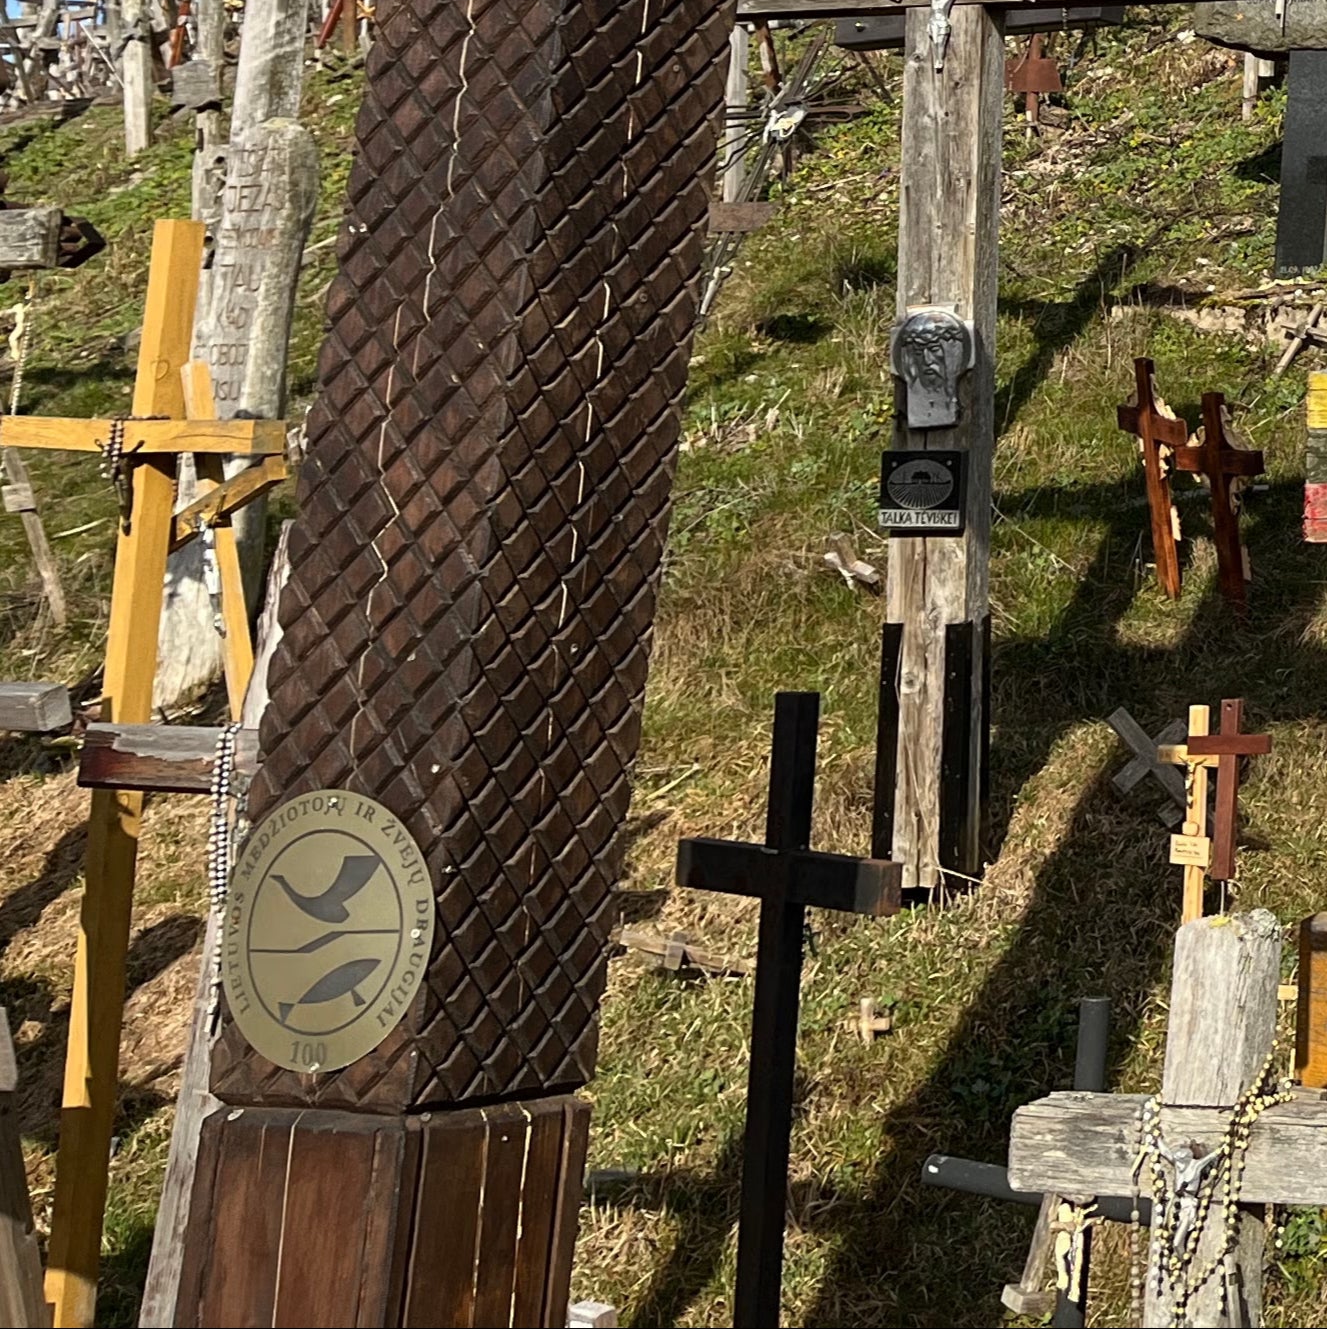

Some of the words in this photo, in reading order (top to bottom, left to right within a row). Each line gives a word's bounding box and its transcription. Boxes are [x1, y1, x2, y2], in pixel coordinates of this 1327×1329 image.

[881, 511, 913, 525] TALKA
[227, 891, 251, 1015] LIETUVOS
[353, 801, 377, 823] IR
[289, 1040, 328, 1066] 100
